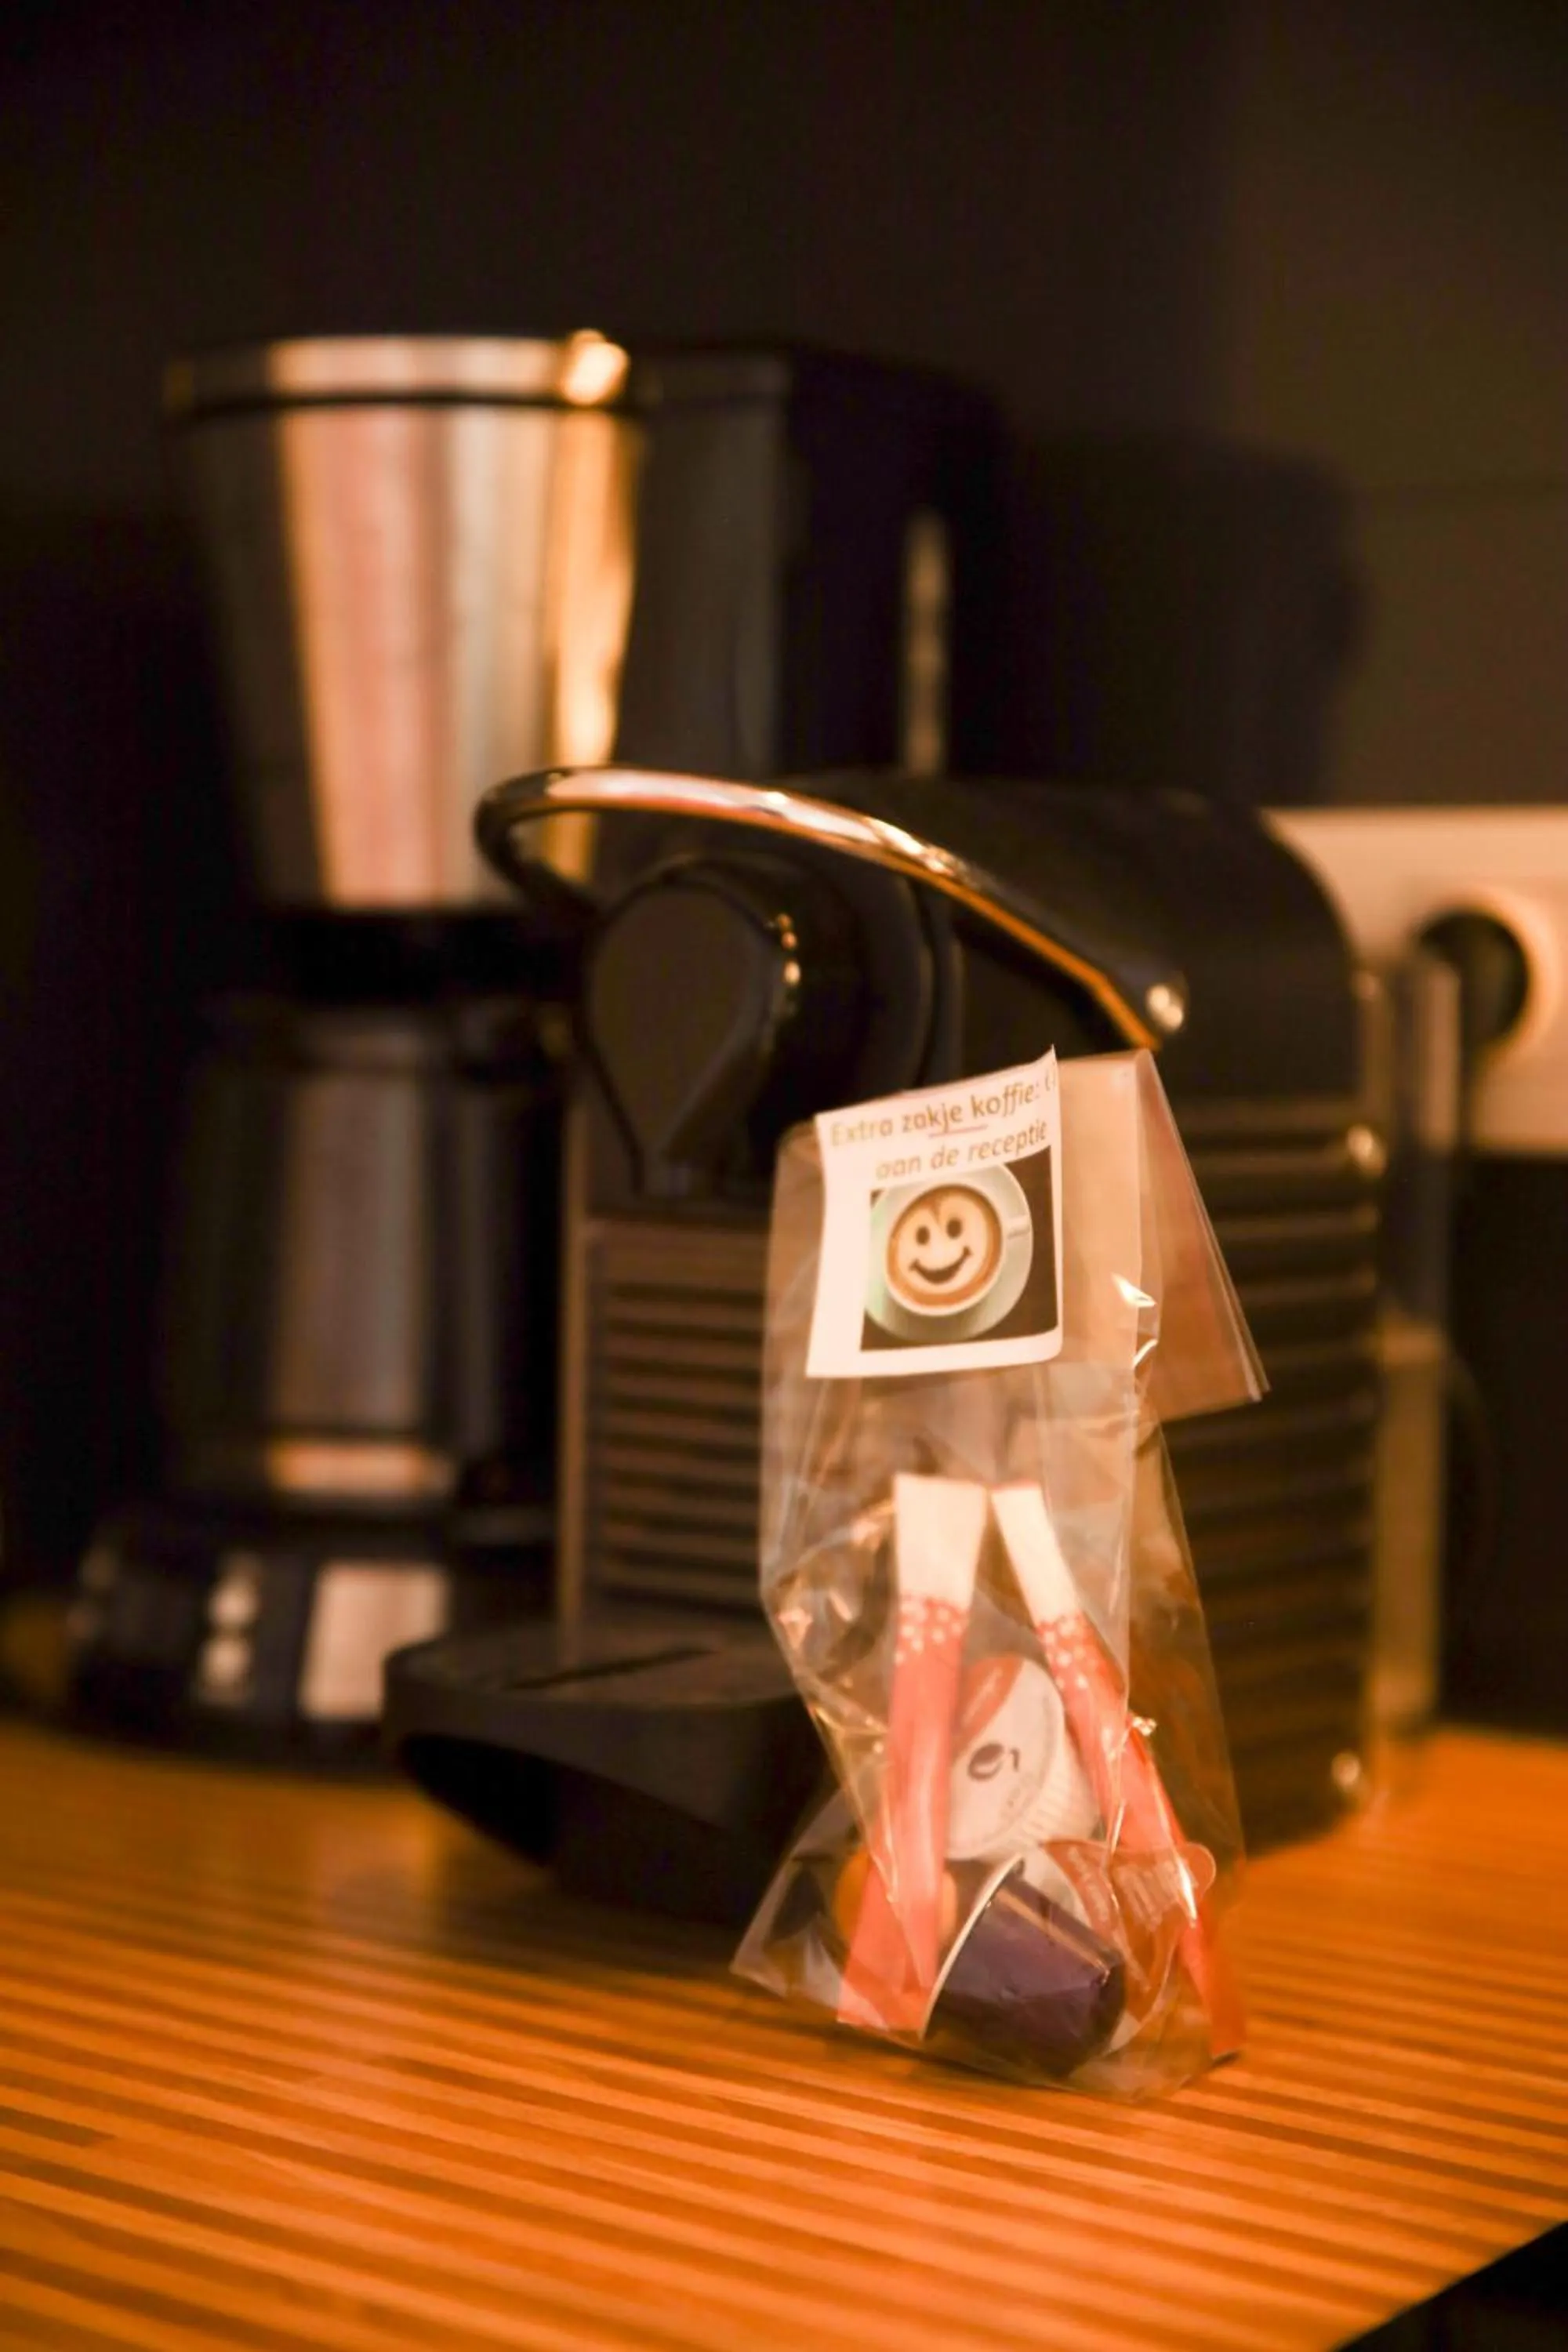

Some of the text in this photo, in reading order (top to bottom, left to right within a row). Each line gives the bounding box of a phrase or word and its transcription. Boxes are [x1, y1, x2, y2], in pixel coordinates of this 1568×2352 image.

[831, 1081, 1040, 1146] Extra zakje koffie:
[875, 1118, 1047, 1180] aan de receptie
